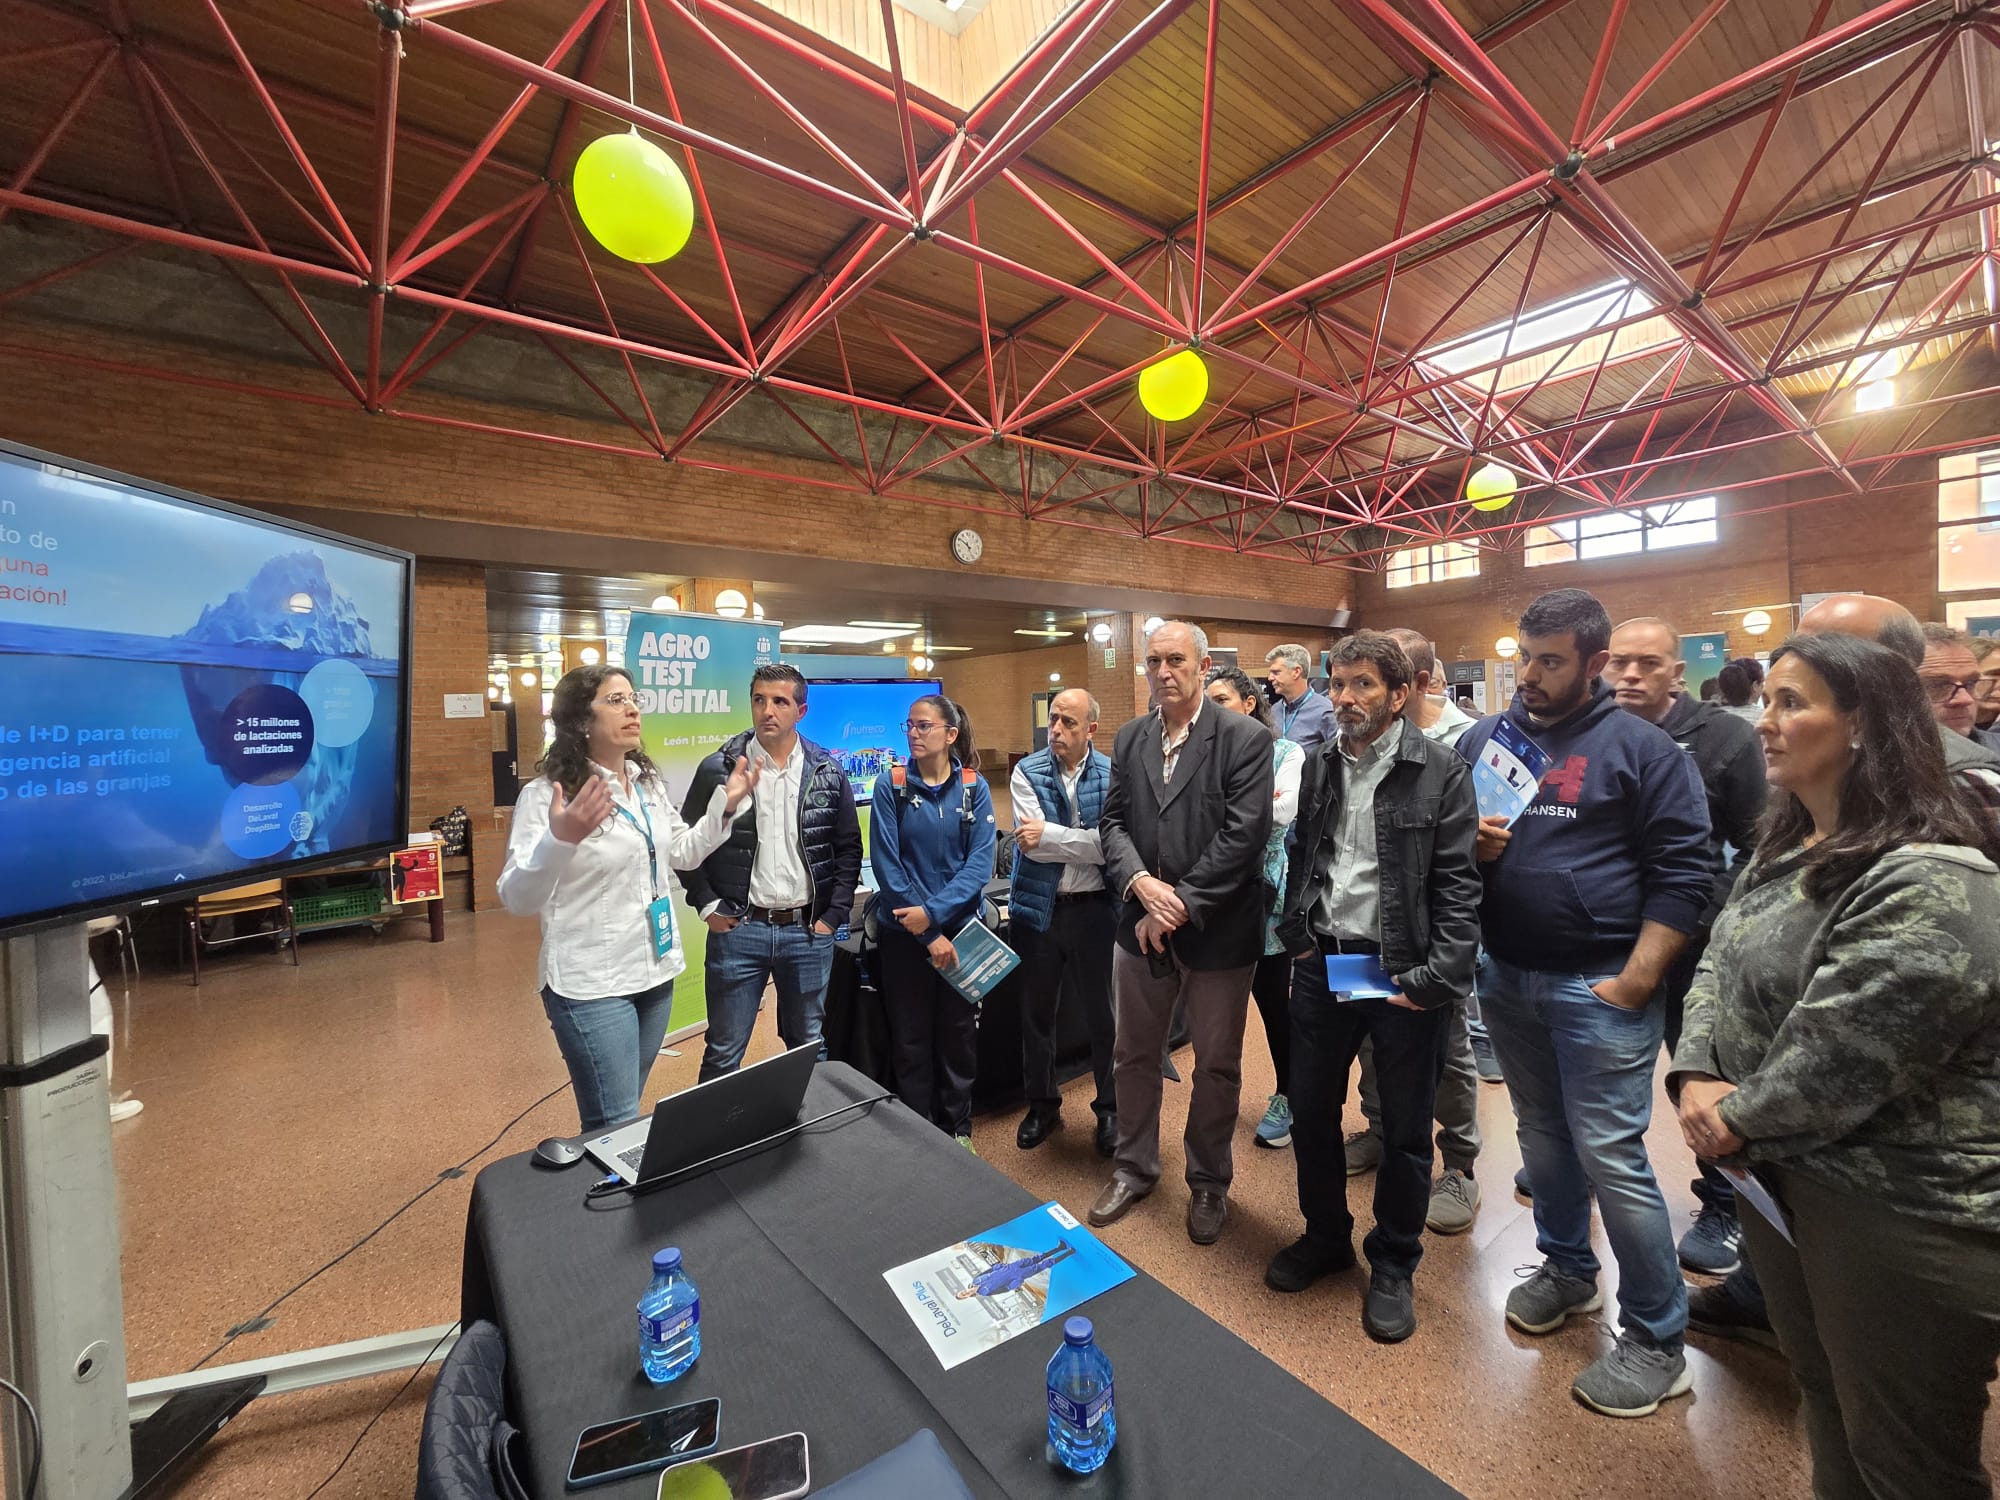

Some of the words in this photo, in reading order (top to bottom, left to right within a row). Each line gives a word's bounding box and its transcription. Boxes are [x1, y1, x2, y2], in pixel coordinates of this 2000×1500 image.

[29, 530, 58, 551] de
[0, 557, 48, 576] una
[0, 585, 66, 606] ación!
[638, 632, 711, 660] AGRO
[638, 659, 697, 686] TEST
[639, 688, 731, 715] DIGITAL
[246, 717, 259, 727] 15
[260, 717, 300, 727] millones
[29, 725, 70, 743] I+D
[77, 728, 125, 746] para
[131, 725, 183, 741] tener
[233, 731, 247, 741] de
[249, 731, 302, 741] lactaciones
[663, 733, 689, 747] León
[243, 744, 294, 755] analizadas
[0, 751, 81, 776] gencia
[88, 749, 171, 767] artificial
[17, 780, 47, 799] de
[55, 778, 89, 796] las
[96, 772, 172, 797] granjas
[1523, 804, 1577, 819] HANSEN
[82, 875, 105, 887] 2022
[912, 1280, 931, 1302] Plus
[922, 1299, 958, 1338] DeLaval
